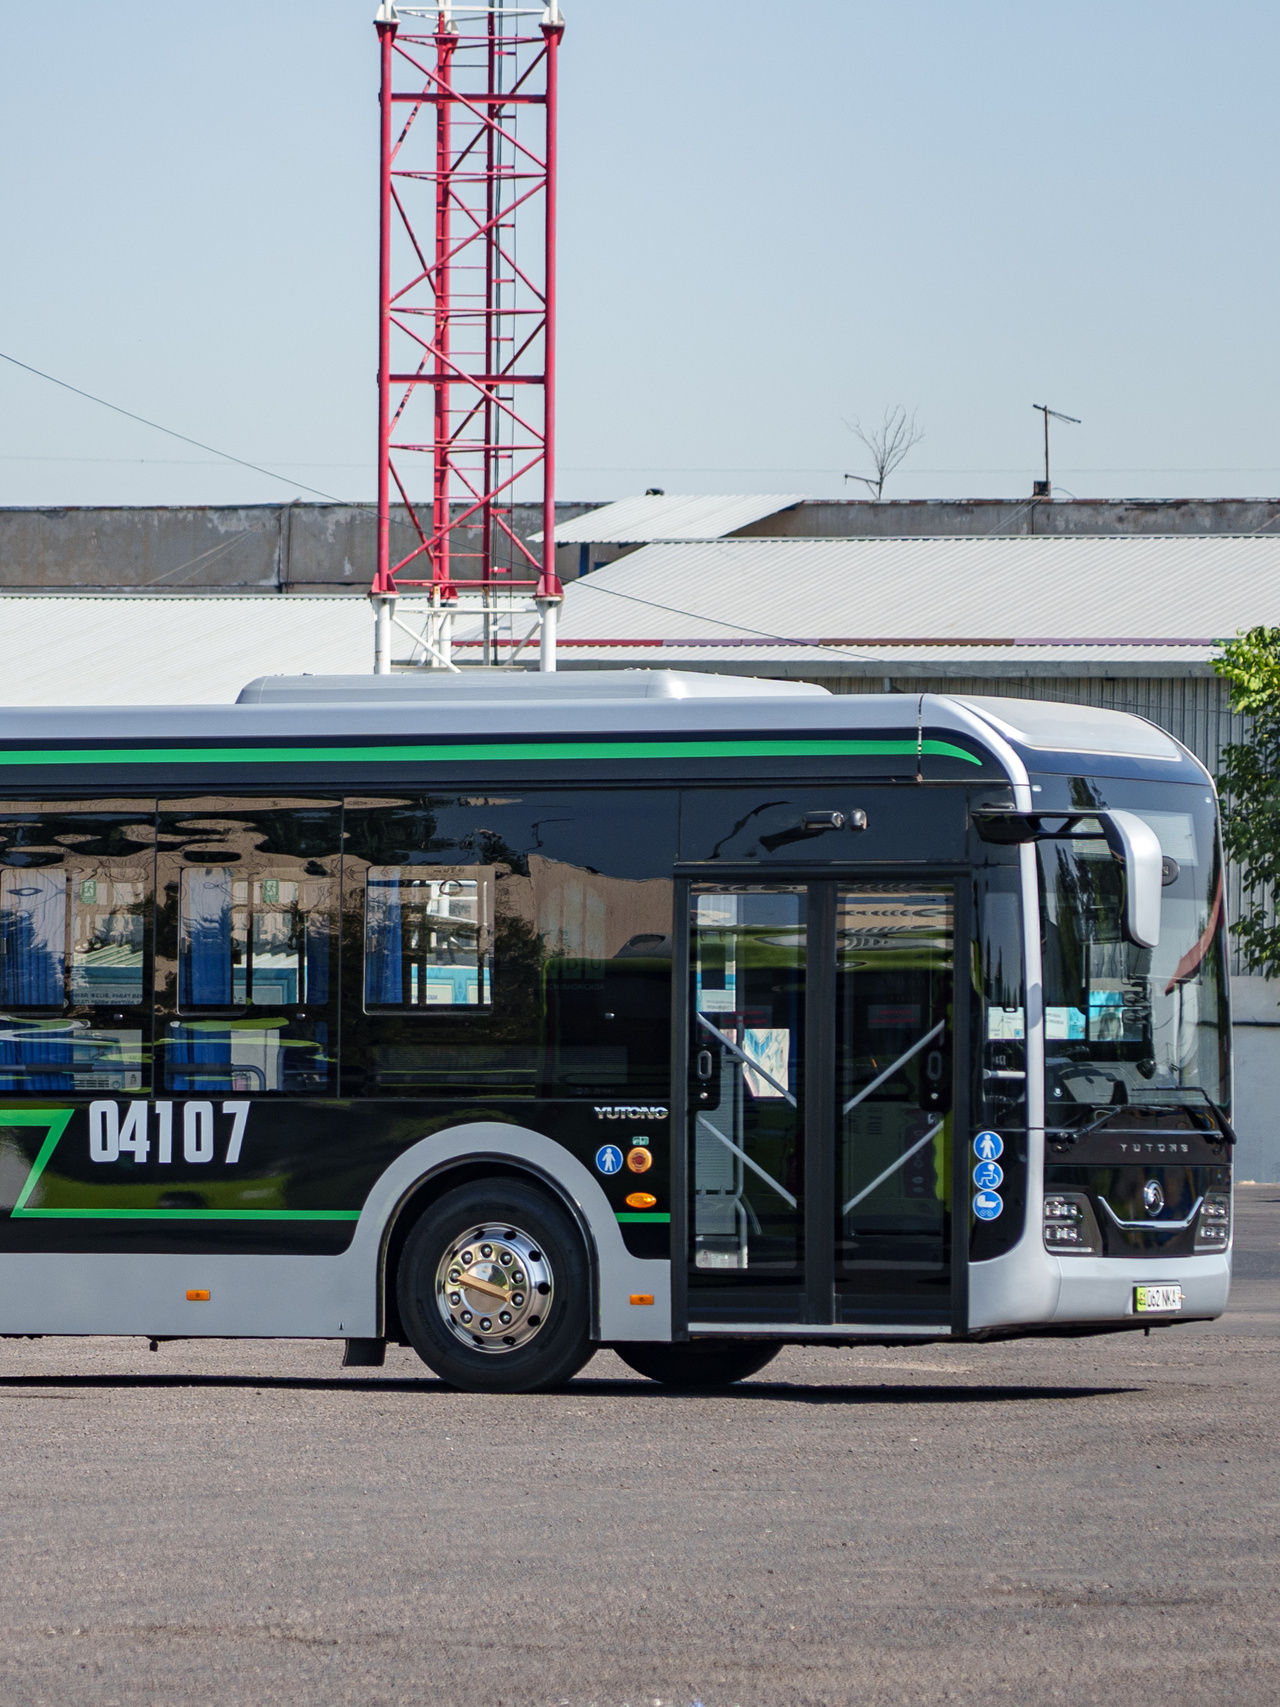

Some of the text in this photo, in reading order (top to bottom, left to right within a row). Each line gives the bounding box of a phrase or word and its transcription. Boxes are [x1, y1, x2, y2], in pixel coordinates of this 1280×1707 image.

[594, 1106, 669, 1119] YUTONG
[89, 1100, 251, 1163] 04107
[1120, 1143, 1189, 1153] YUTONG
